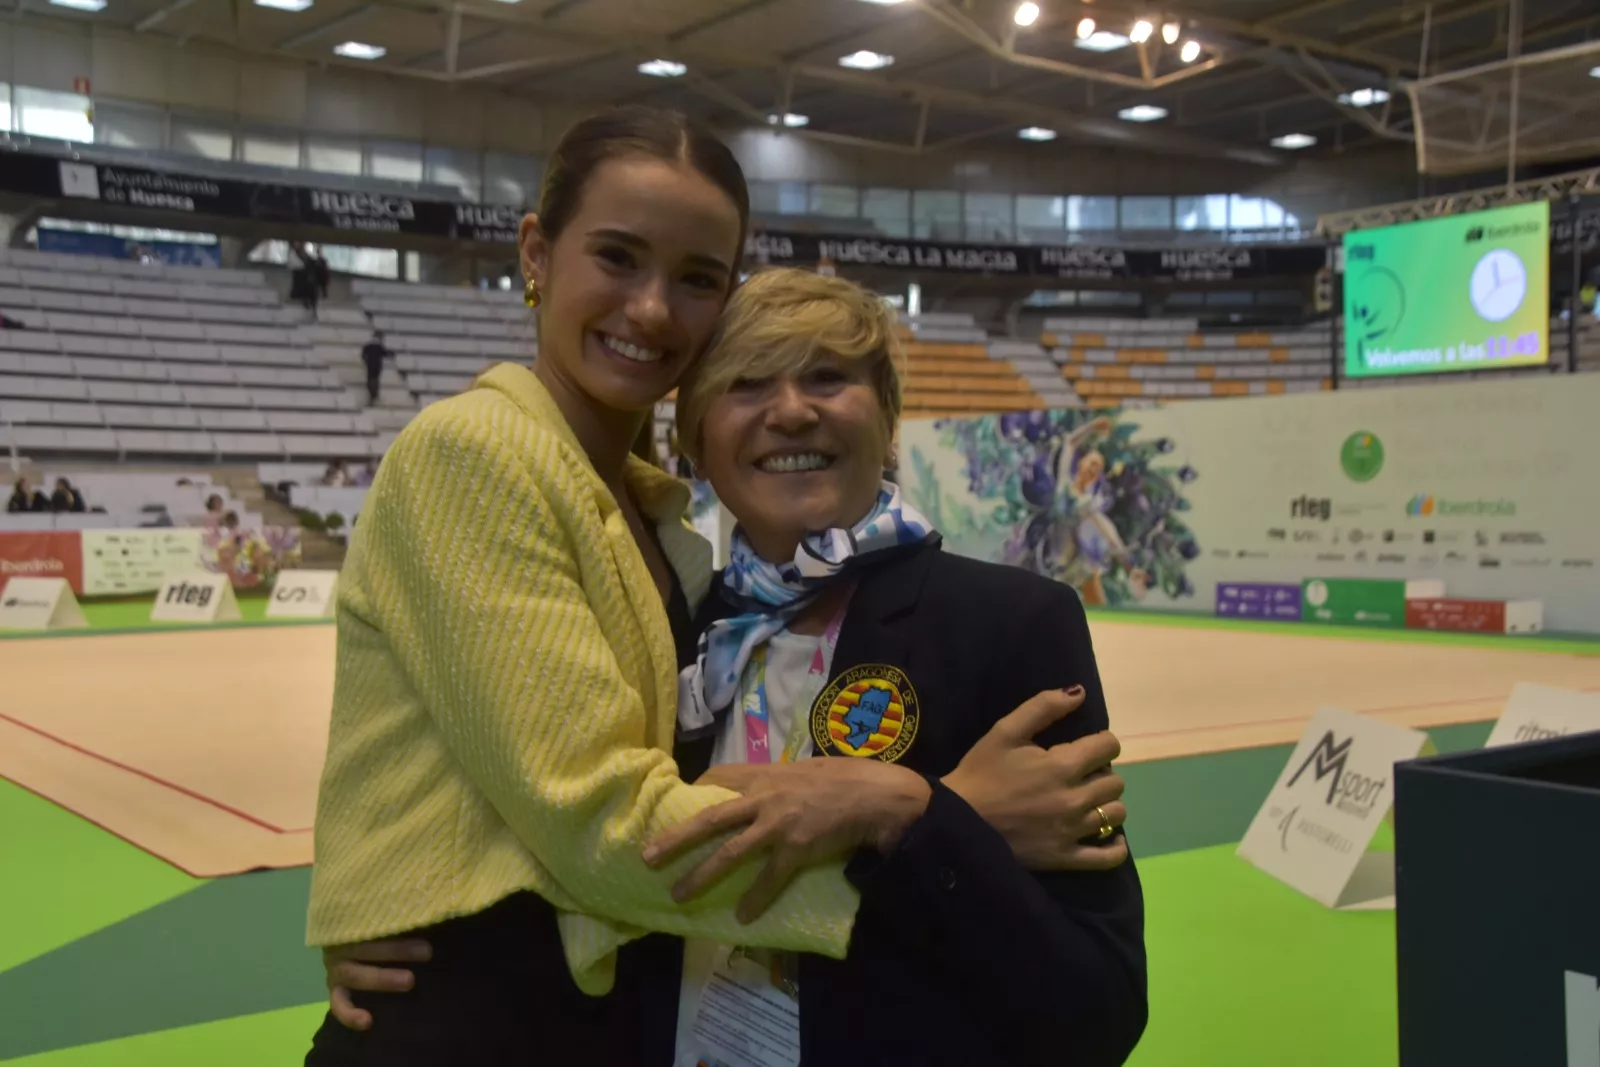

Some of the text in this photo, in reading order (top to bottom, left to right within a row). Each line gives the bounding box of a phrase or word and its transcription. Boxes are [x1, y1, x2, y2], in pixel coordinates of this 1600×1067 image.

[104, 167, 220, 197] Ayuntamiento
[105, 187, 195, 211] de Huesca
[1366, 347, 1441, 367] Volvemos
[1458, 340, 1484, 361] las
[902, 689, 915, 705] DE
